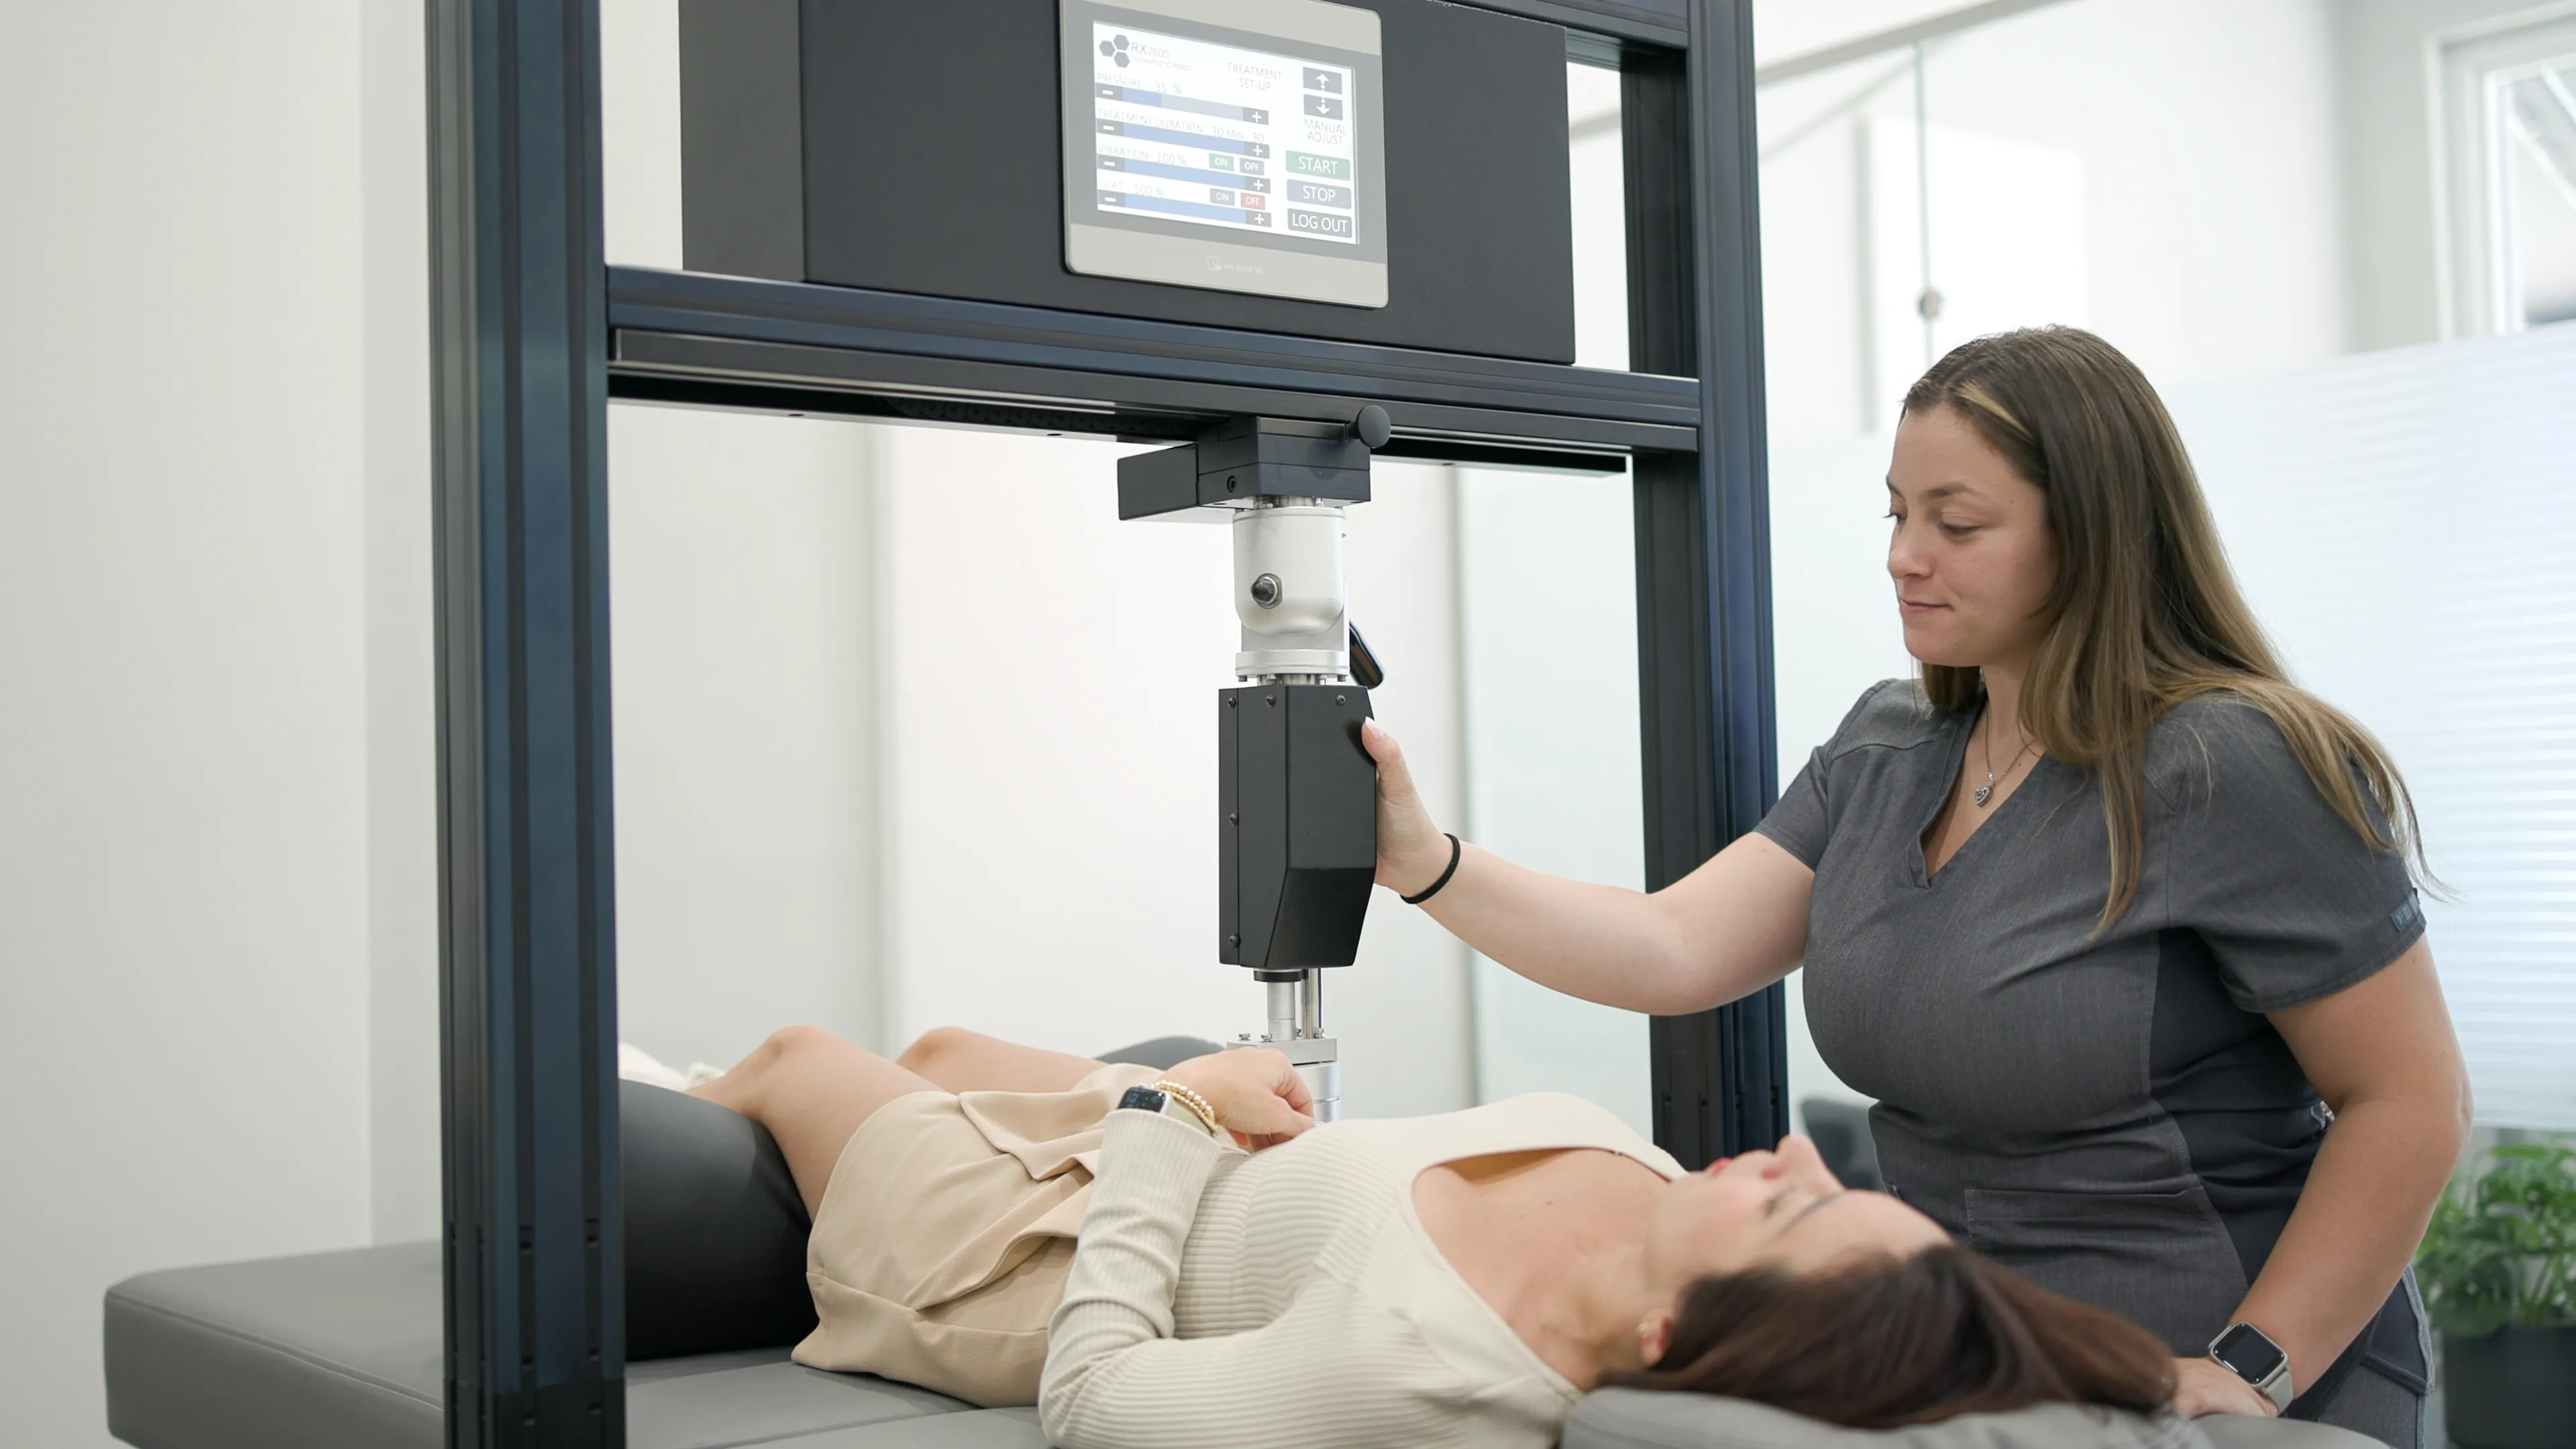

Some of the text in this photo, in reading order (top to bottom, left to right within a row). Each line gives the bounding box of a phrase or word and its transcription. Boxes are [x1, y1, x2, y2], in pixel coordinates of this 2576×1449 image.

[1131, 42, 1169, 58] RX2600
[1227, 62, 1282, 80] TREATMENT
[1155, 82, 1167, 94] 35
[1173, 84, 1183, 95] %
[1239, 77, 1271, 91] SET-UP
[1098, 108, 1152, 125] TREATMENT
[1212, 126, 1224, 138] 30
[1227, 128, 1244, 140] MIN
[1304, 119, 1347, 136] MANUAL
[1307, 131, 1344, 146] ADJUST
[1157, 152, 1175, 164] 100
[1177, 155, 1187, 166] %
[1214, 157, 1228, 167] ON
[1299, 156, 1338, 175] START
[1244, 162, 1259, 171] OFF
[1135, 184, 1152, 196] 100
[1155, 186, 1165, 198] %
[1216, 192, 1229, 202] ON
[1303, 185, 1336, 202] STOP
[1245, 196, 1260, 206] OFF
[1292, 213, 1348, 233] LOG OUT
